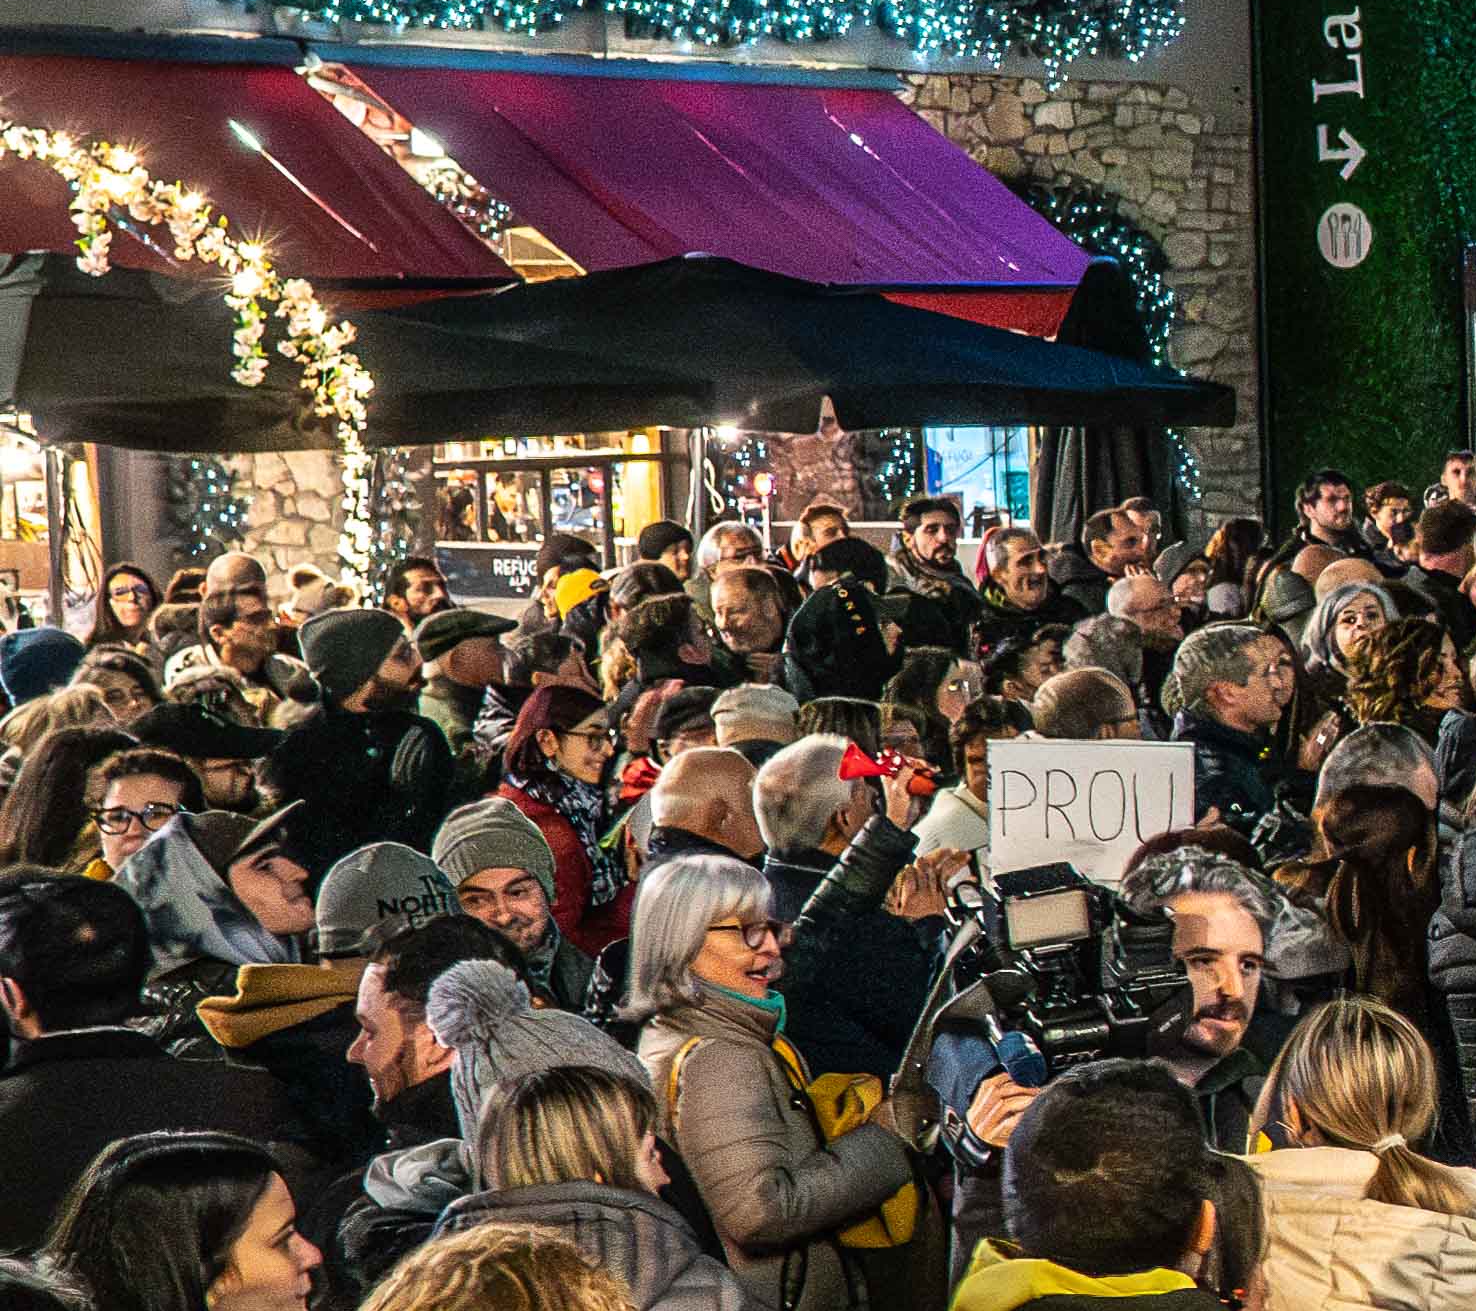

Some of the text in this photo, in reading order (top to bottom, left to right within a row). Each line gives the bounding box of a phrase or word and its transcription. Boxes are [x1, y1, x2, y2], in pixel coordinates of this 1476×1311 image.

[1312, 6, 1365, 104] La
[493, 558, 538, 576] REFUG
[377, 895, 448, 919] NORT
